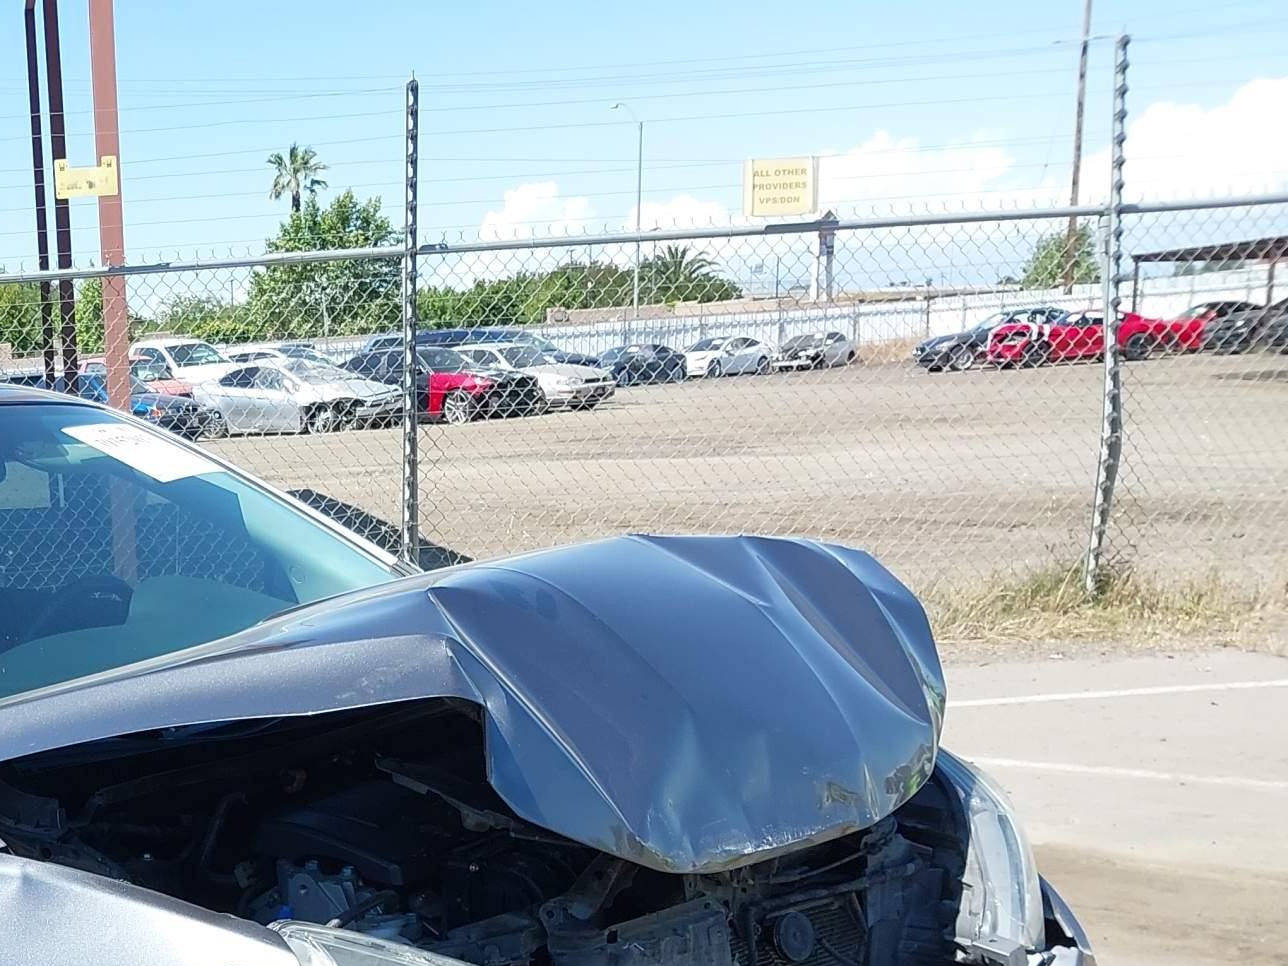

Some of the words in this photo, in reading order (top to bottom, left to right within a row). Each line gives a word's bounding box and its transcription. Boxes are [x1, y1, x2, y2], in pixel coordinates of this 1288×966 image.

[753, 169, 772, 177] ALL
[774, 168, 808, 177] OTHER
[753, 181, 808, 191] PROVIDERS
